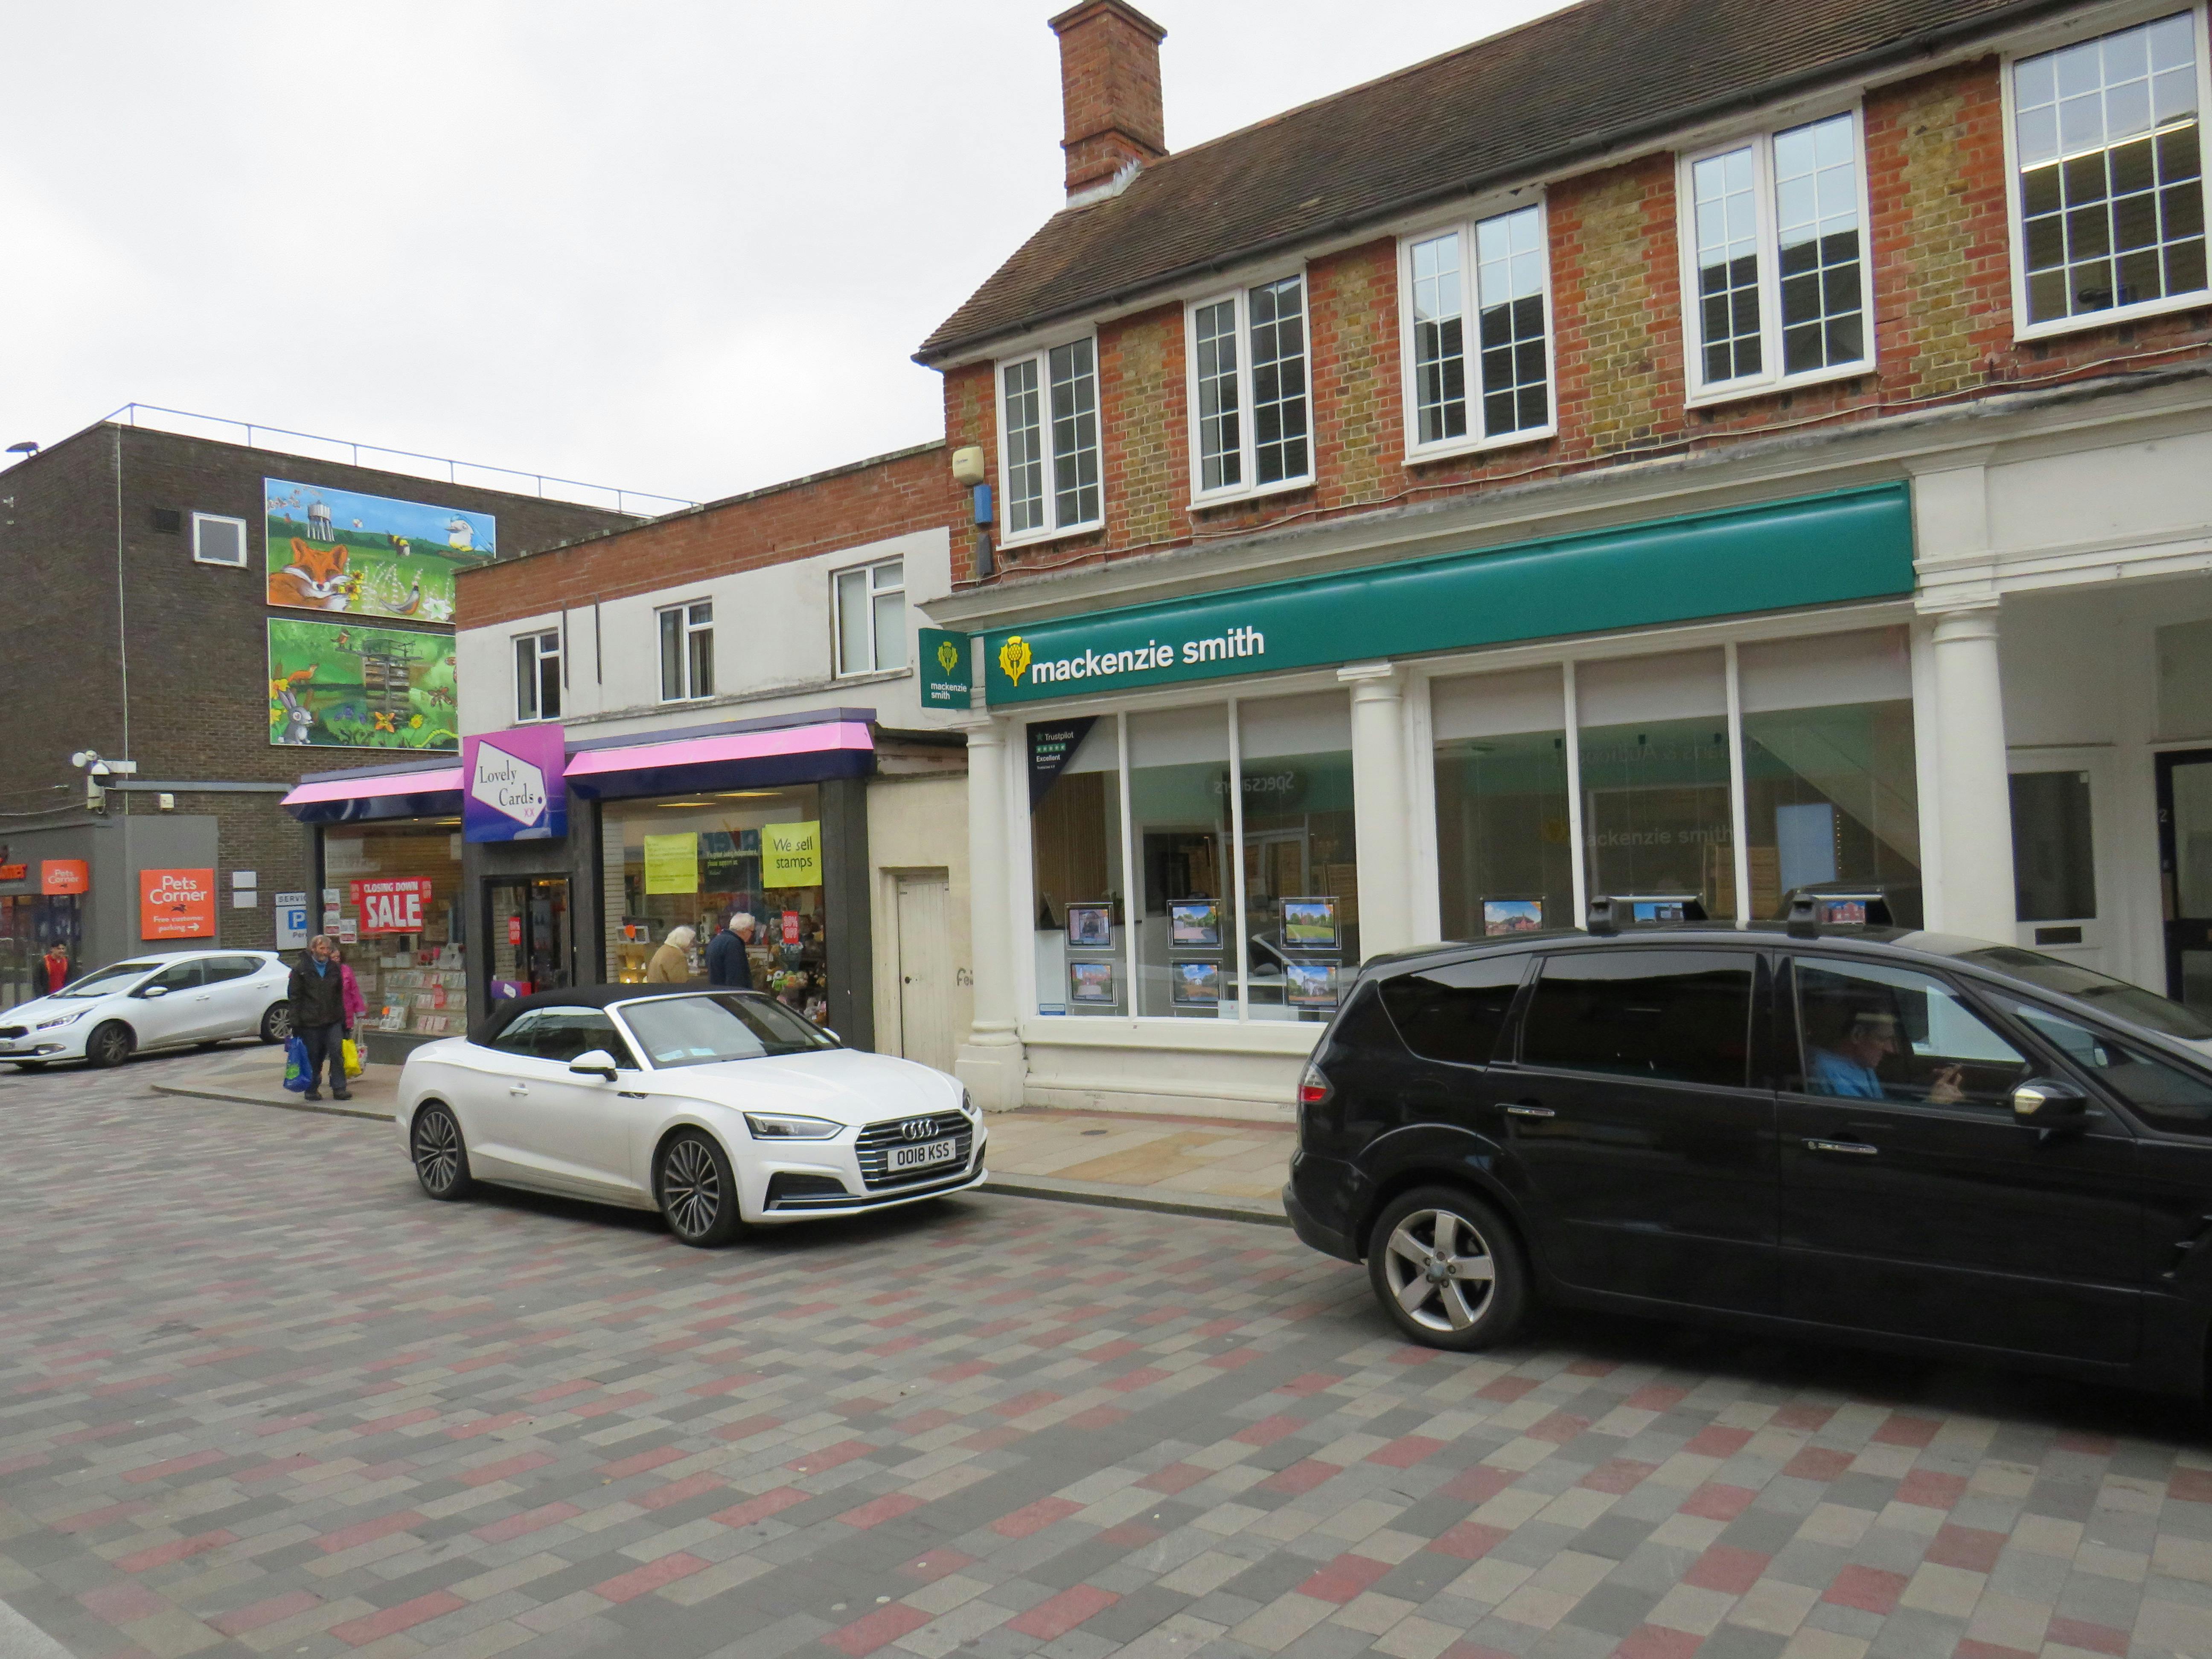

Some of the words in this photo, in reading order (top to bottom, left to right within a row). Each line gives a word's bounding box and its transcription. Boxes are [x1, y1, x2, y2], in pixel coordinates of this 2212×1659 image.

[1032, 640, 1174, 684] mackenzie
[1182, 626, 1265, 664] smith
[931, 682, 967, 692] mackenzie
[931, 691, 950, 699] smith
[1045, 731, 1074, 741] Trustpilot
[479, 760, 517, 785] Lovely
[499, 783, 533, 806] Cards
[773, 838, 792, 852] We
[796, 836, 812, 851] sell
[777, 857, 812, 871] stamps
[162, 876, 197, 890] Pets
[364, 883, 393, 892] CLOSING
[395, 881, 418, 891] DOWN
[150, 889, 207, 905] Corner
[366, 894, 422, 928] SALE
[292, 911, 305, 928] P
[158, 924, 186, 933] parking
[928, 1142, 949, 1161] KSS
